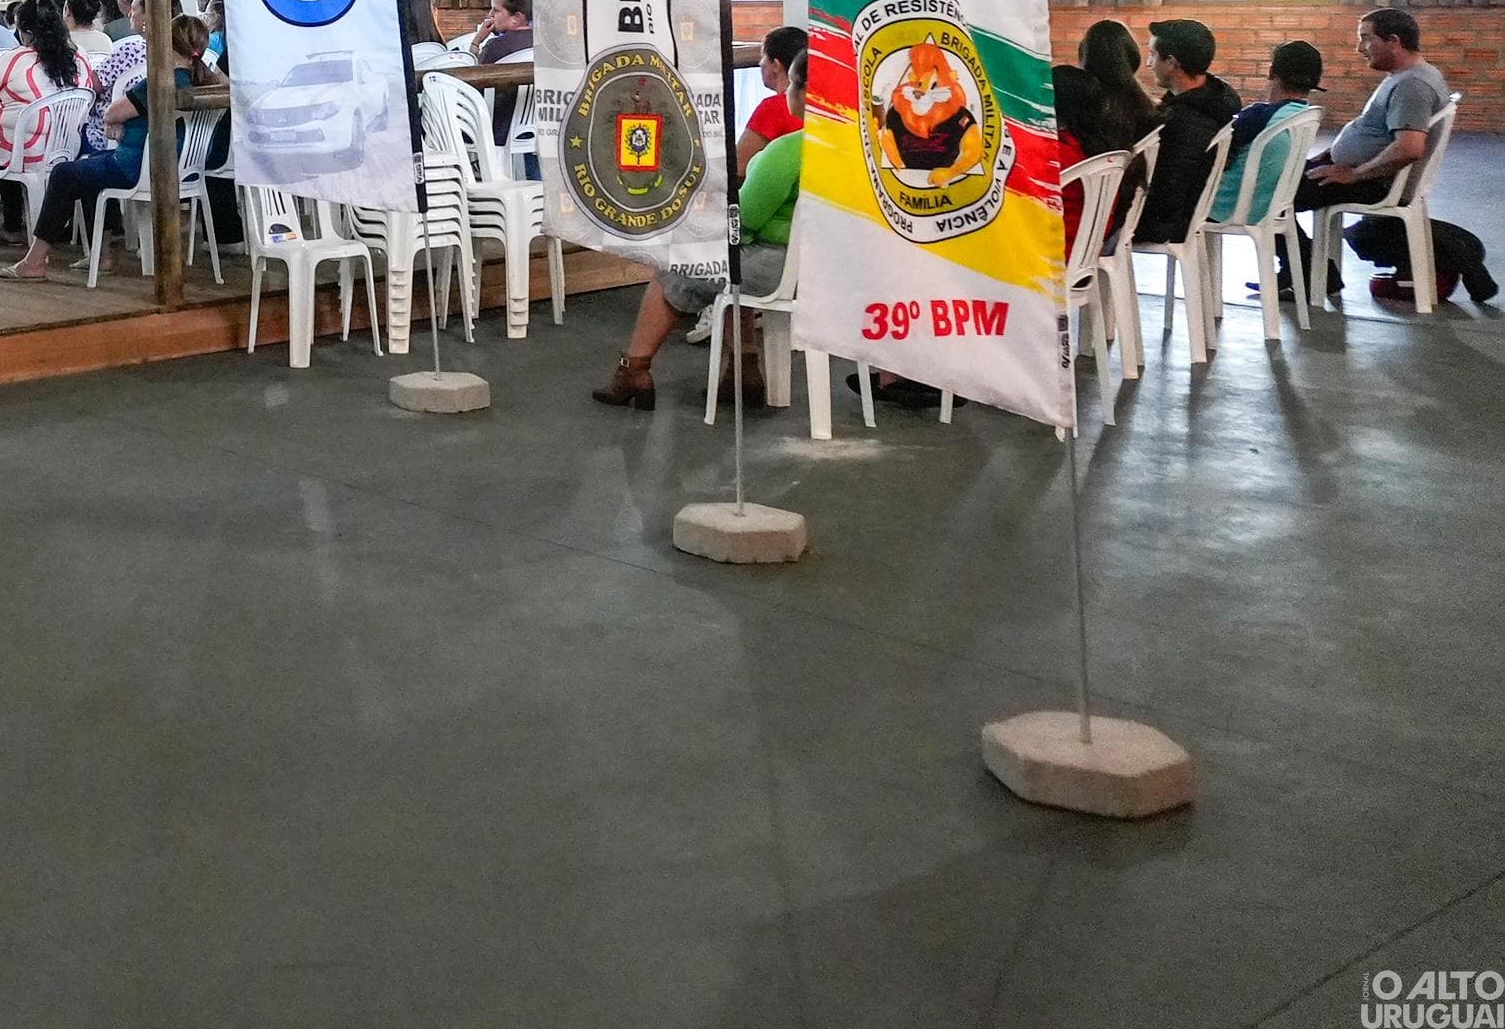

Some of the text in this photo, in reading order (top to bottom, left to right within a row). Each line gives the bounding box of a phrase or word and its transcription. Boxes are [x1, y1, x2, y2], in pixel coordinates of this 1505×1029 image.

[862, 9, 882, 31] DE
[941, 32, 986, 91] BRIGADA
[578, 54, 644, 117] BRIGADA
[574, 163, 702, 228] RIO GRANDE DO SUL
[899, 191, 953, 210] FAMÍLIA
[936, 177, 1002, 232] VIOLÊNCIA
[670, 260, 728, 276] BRIGADA
[930, 299, 1010, 338] BPM
